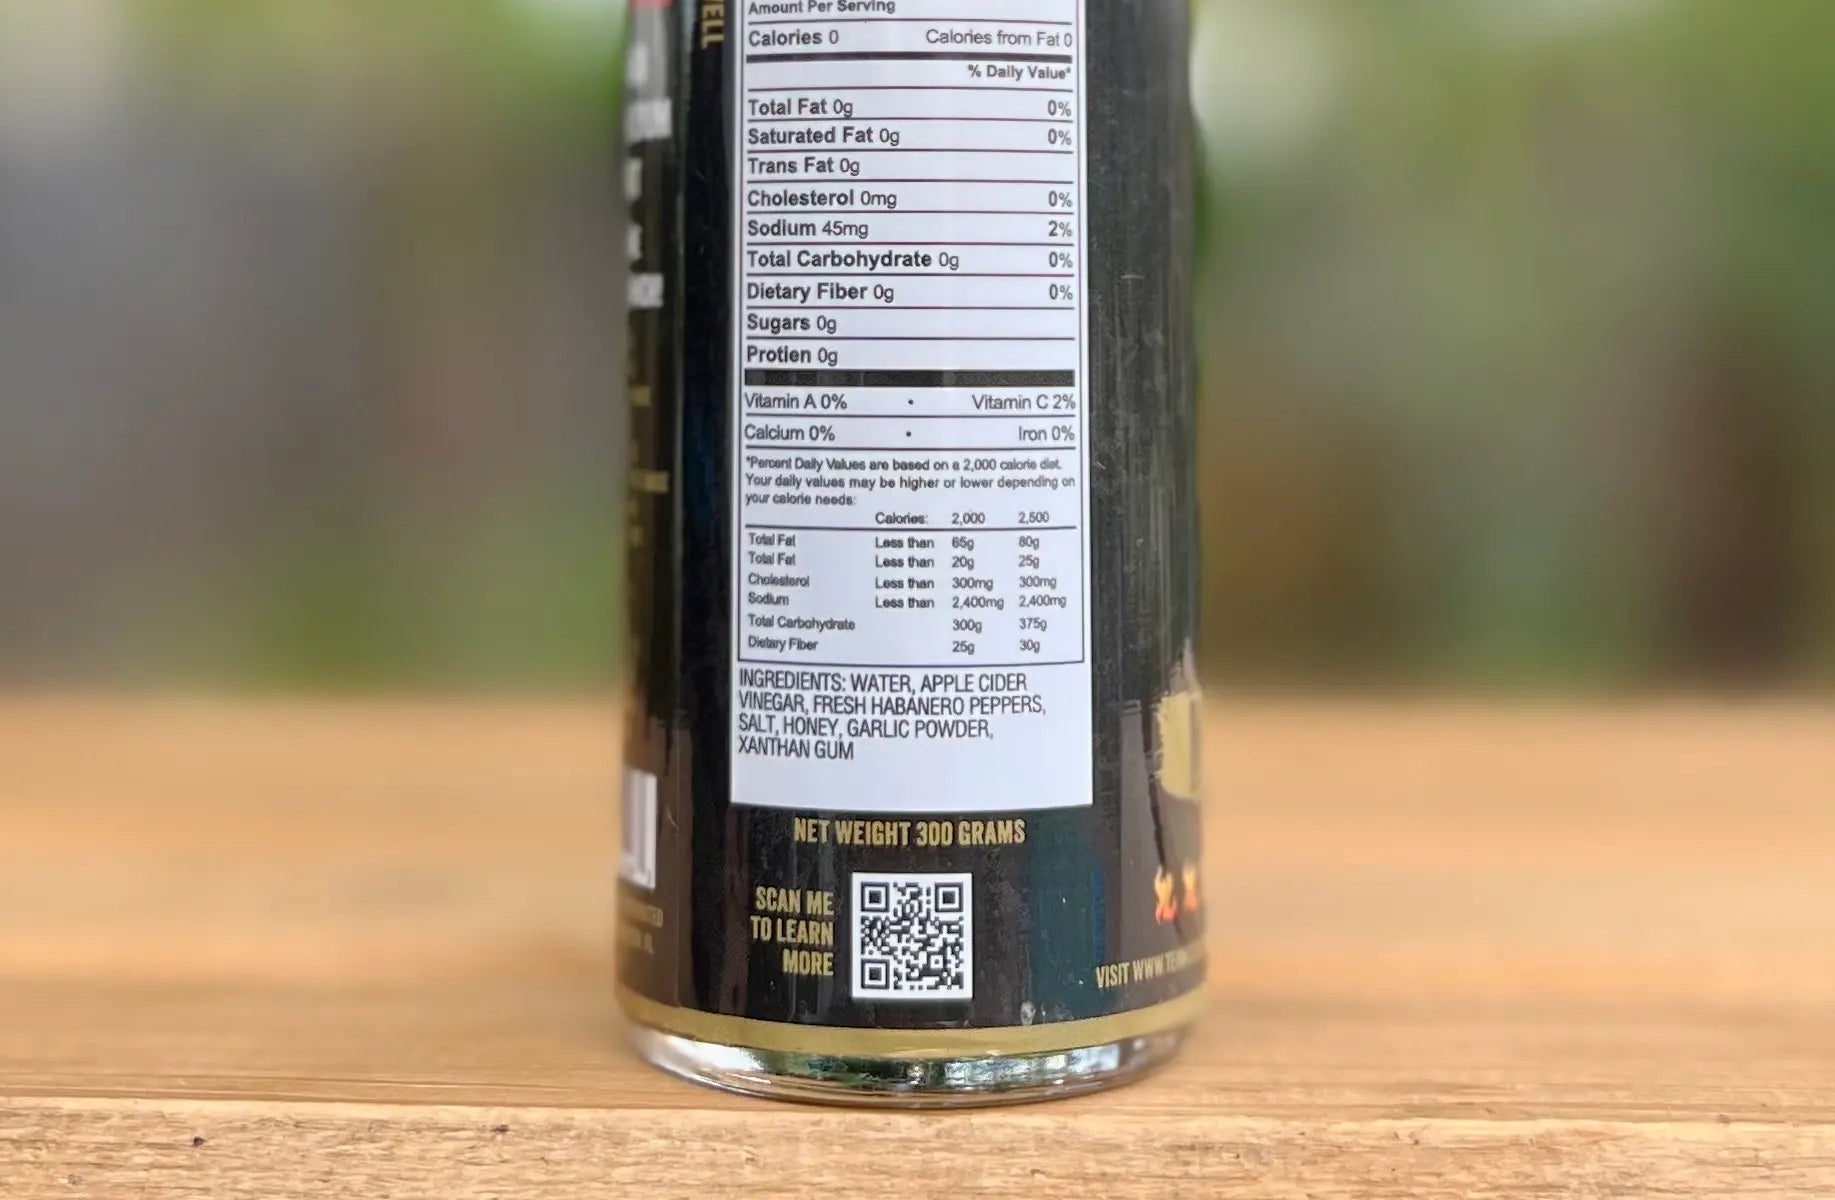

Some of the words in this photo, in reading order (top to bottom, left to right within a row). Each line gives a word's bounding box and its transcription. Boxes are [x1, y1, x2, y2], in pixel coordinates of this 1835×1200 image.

[749, 0, 804, 15] Amount
[808, 0, 833, 13] Per
[837, 0, 895, 15] Serving
[749, 30, 822, 46] Calories
[828, 31, 839, 44] 0
[926, 29, 992, 44] Calories
[997, 30, 1031, 45] from
[1037, 31, 1060, 46] Fat
[1064, 33, 1072, 47] 0
[987, 65, 1023, 80] Daily
[748, 100, 791, 115] Total
[798, 99, 827, 115] Fat
[833, 100, 853, 117] 0g
[1047, 101, 1072, 116] 0%
[748, 127, 836, 144] Saturated
[842, 127, 873, 143] Fat
[879, 128, 900, 146] 0g
[1047, 129, 1072, 145] 0%
[747, 158, 797, 174] Trans
[804, 157, 834, 173] Fat
[839, 158, 860, 176] 0g
[747, 190, 854, 207] Cholesterol
[860, 190, 897, 209] 0mg
[1048, 191, 1073, 207] 0%
[747, 220, 816, 237] Sodium
[822, 221, 869, 239] 45mg
[1048, 221, 1073, 237] 2%
[747, 251, 791, 267] Total
[797, 251, 932, 268] Carbohydrate
[939, 251, 959, 270] 0g
[1049, 253, 1073, 268] 0%
[747, 284, 810, 303] Dietary
[817, 284, 867, 299] Fiber
[873, 284, 894, 303] 0g
[1049, 285, 1073, 301] 0%
[747, 314, 810, 333] Sugars
[816, 315, 837, 333] 0g
[747, 346, 811, 363] Protien
[817, 347, 838, 365] 0g
[744, 394, 799, 409] Vitamin
[803, 394, 817, 409] A
[821, 394, 847, 409] 0%
[972, 394, 1032, 410] Vitamin
[1037, 395, 1048, 409] C
[1052, 394, 1076, 410] 2%
[744, 425, 804, 440] Calcium
[809, 426, 835, 441] 0%
[1018, 426, 1047, 441] Iron
[1051, 426, 1075, 441] 0%
[795, 458, 822, 472] Daily
[869, 461, 888, 470] are
[893, 459, 930, 470] based
[934, 461, 949, 470] on
[963, 459, 997, 472] 2,000
[746, 475, 771, 486] Your
[775, 475, 802, 489] daily
[806, 476, 845, 488] values
[849, 478, 875, 490] may
[880, 476, 896, 488] be
[900, 477, 939, 490] higher
[944, 478, 956, 488] or
[960, 477, 993, 489] lower
[997, 476, 1058, 490] depending
[1062, 478, 1075, 487] on
[746, 494, 770, 506] your
[952, 512, 985, 525] 2,000
[748, 534, 775, 546] Total
[778, 534, 795, 546] Fat
[875, 537, 903, 549] Less
[908, 537, 935, 549] than
[1019, 536, 1039, 550] 80g
[748, 553, 775, 565] Total
[778, 553, 795, 565] Fat
[875, 556, 903, 568] Less
[908, 556, 935, 568] than
[952, 556, 974, 570] 20g
[1018, 556, 1039, 570] 25g
[748, 574, 810, 587] Cholesterol
[875, 577, 903, 589] Less
[908, 577, 935, 589] than
[952, 577, 993, 592] 300mg
[1019, 576, 1056, 590] 300mg
[748, 593, 789, 606] Sodium
[875, 596, 903, 609] Less
[908, 596, 935, 609] than
[748, 614, 774, 627] Total
[778, 615, 855, 632] Carbohydrate
[952, 619, 982, 634] 300g
[1019, 618, 1047, 632] 375g
[748, 635, 786, 651] Dietary
[789, 637, 818, 651] Fiber
[952, 640, 975, 655] 25g
[1020, 640, 1040, 654] 30g
[740, 669, 846, 691] INGREDIENTS:
[920, 673, 974, 692] APPLE
[979, 672, 1027, 692] CIDER
[813, 696, 865, 715] FRESH
[872, 696, 964, 716] HABANERO
[847, 718, 910, 738] GARLIC
[739, 736, 810, 758] XANTHAN
[814, 739, 854, 760] GUM
[795, 818, 830, 843] NET
[836, 821, 909, 846] WEIGHT
[918, 820, 952, 847] 300
[959, 819, 1026, 845] GRAMS
[756, 886, 801, 913] SCAN
[807, 890, 834, 914] ME
[751, 916, 771, 941] TO
[776, 918, 834, 945] LEARN
[783, 949, 834, 976] MORE
[1096, 961, 1130, 988] VISIT
